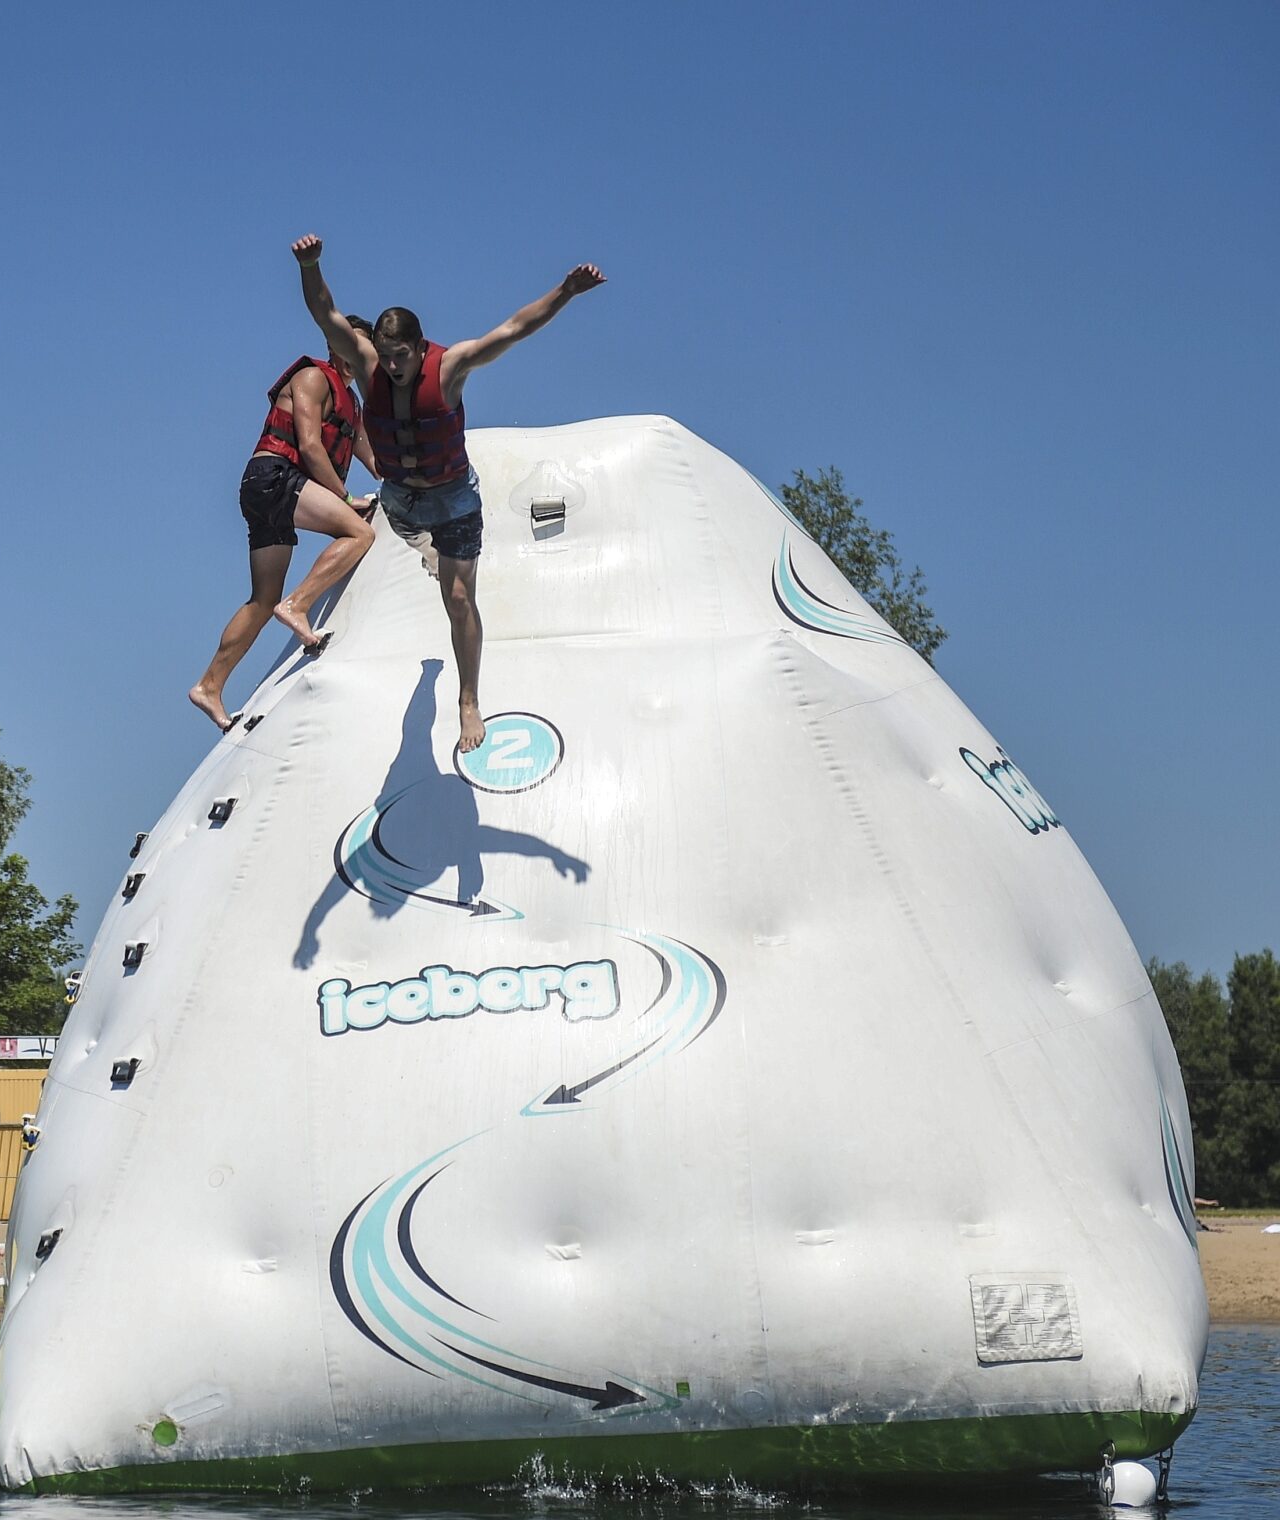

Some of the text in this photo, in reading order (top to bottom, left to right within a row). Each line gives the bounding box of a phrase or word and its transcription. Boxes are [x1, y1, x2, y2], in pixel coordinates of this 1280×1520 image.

[487, 729, 534, 769] 2
[959, 746, 1062, 835] ice
[318, 959, 621, 1037] iceberg
